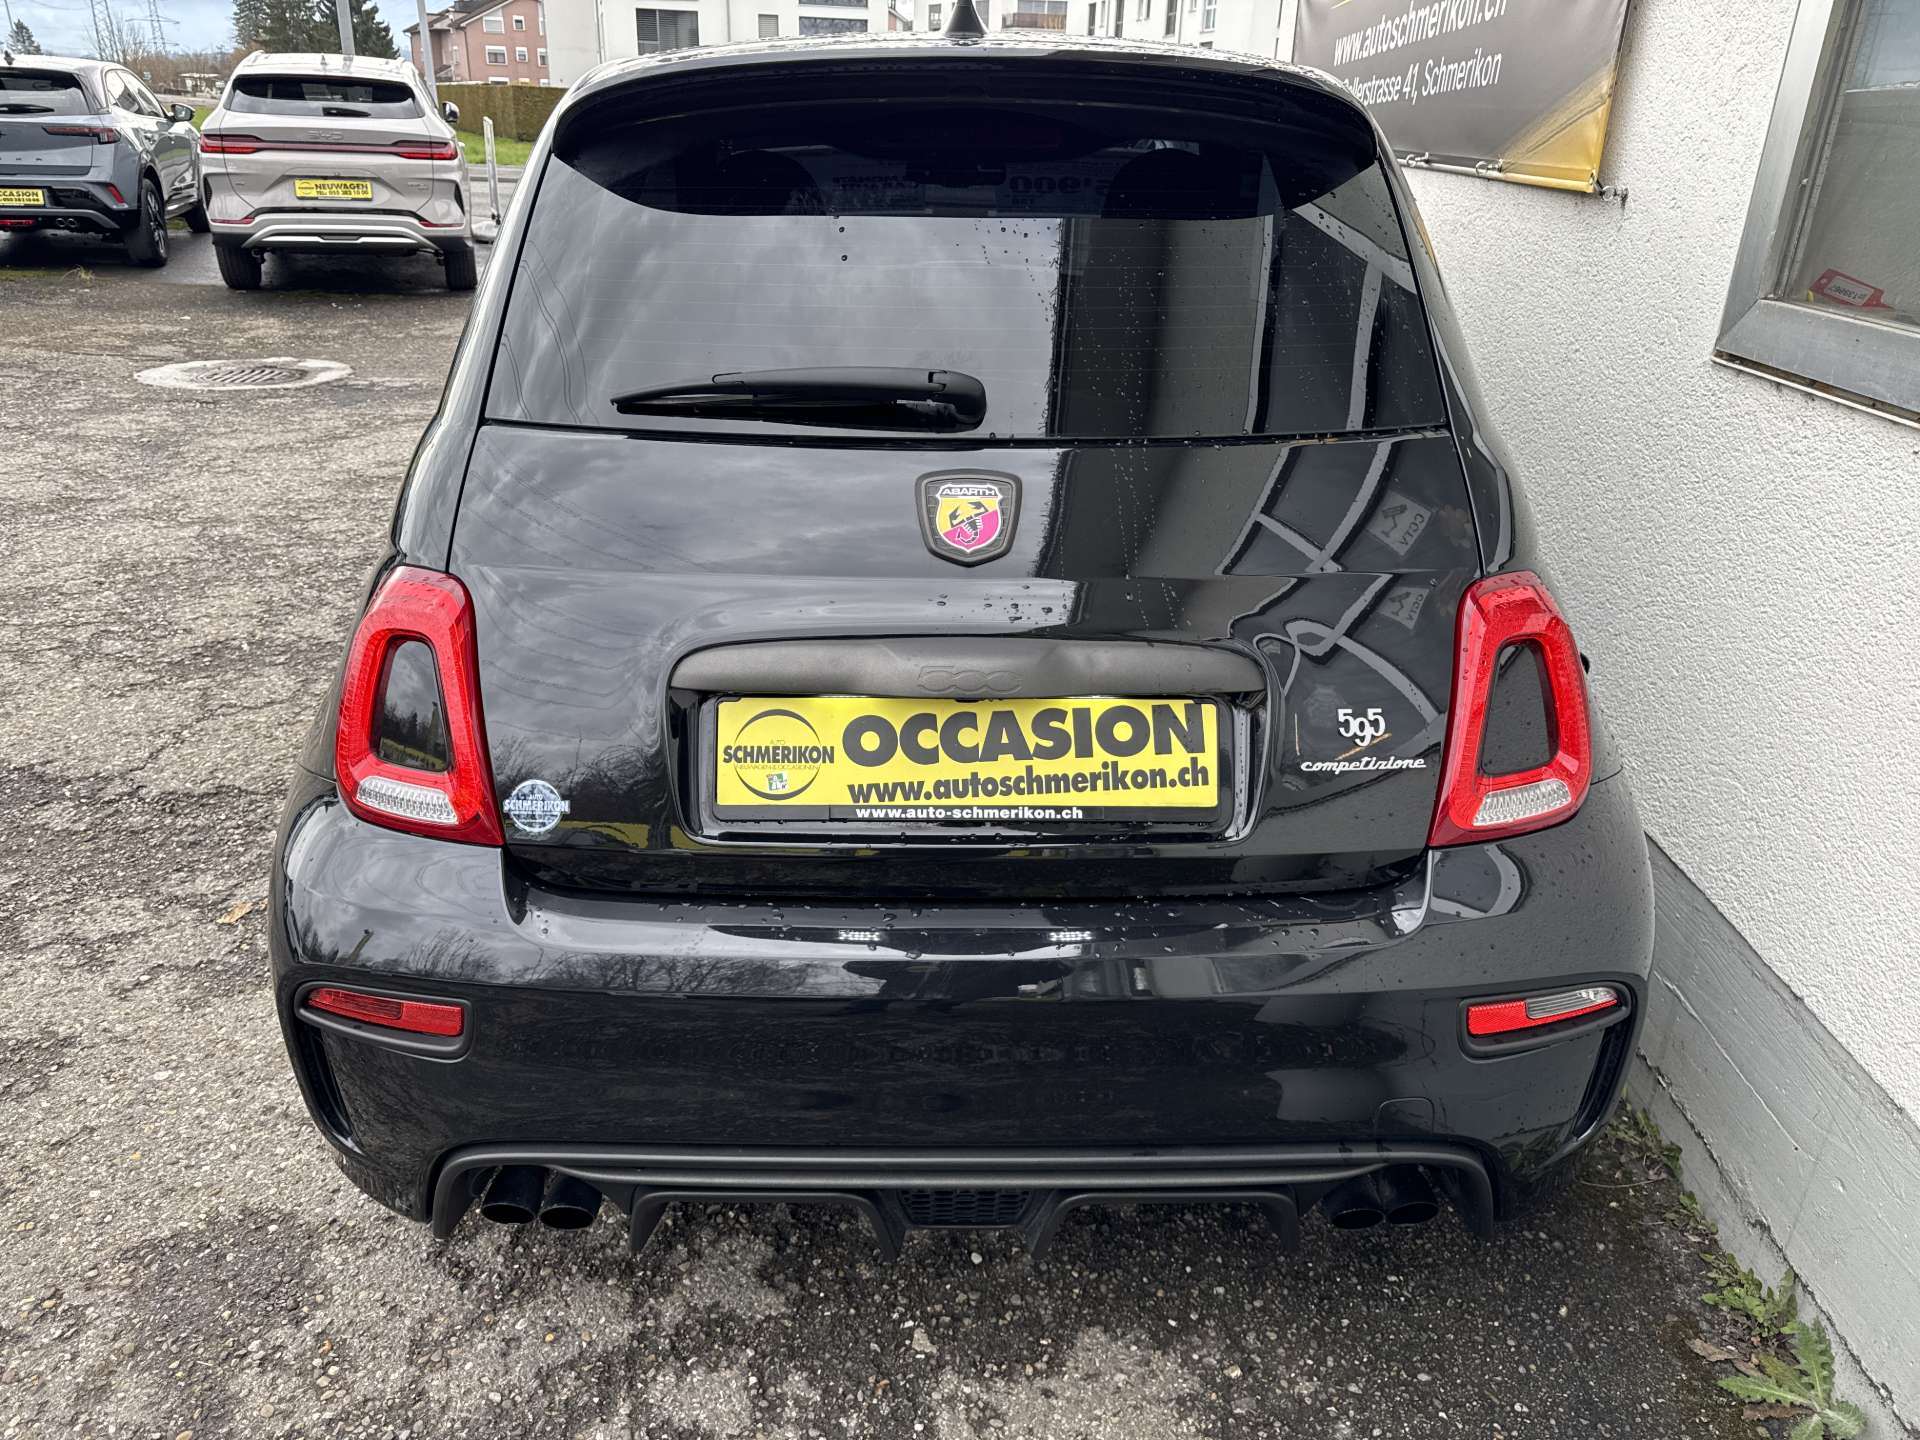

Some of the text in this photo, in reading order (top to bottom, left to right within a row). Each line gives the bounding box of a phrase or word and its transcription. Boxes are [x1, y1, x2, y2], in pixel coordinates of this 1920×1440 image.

[1343, 48, 1502, 106] llerstrasse 41, Schmerikon
[942, 488, 995, 496] ABARTH
[842, 703, 1206, 767] OCCASION
[1337, 708, 1386, 747] 595
[723, 745, 835, 764] SCHMERIKON
[1300, 756, 1427, 775] competizione
[848, 757, 1210, 804] www.autoschmerikon.ch
[504, 800, 569, 812] SCHMERIKON
[856, 806, 1084, 820] www.auto-schmerikon.ch
